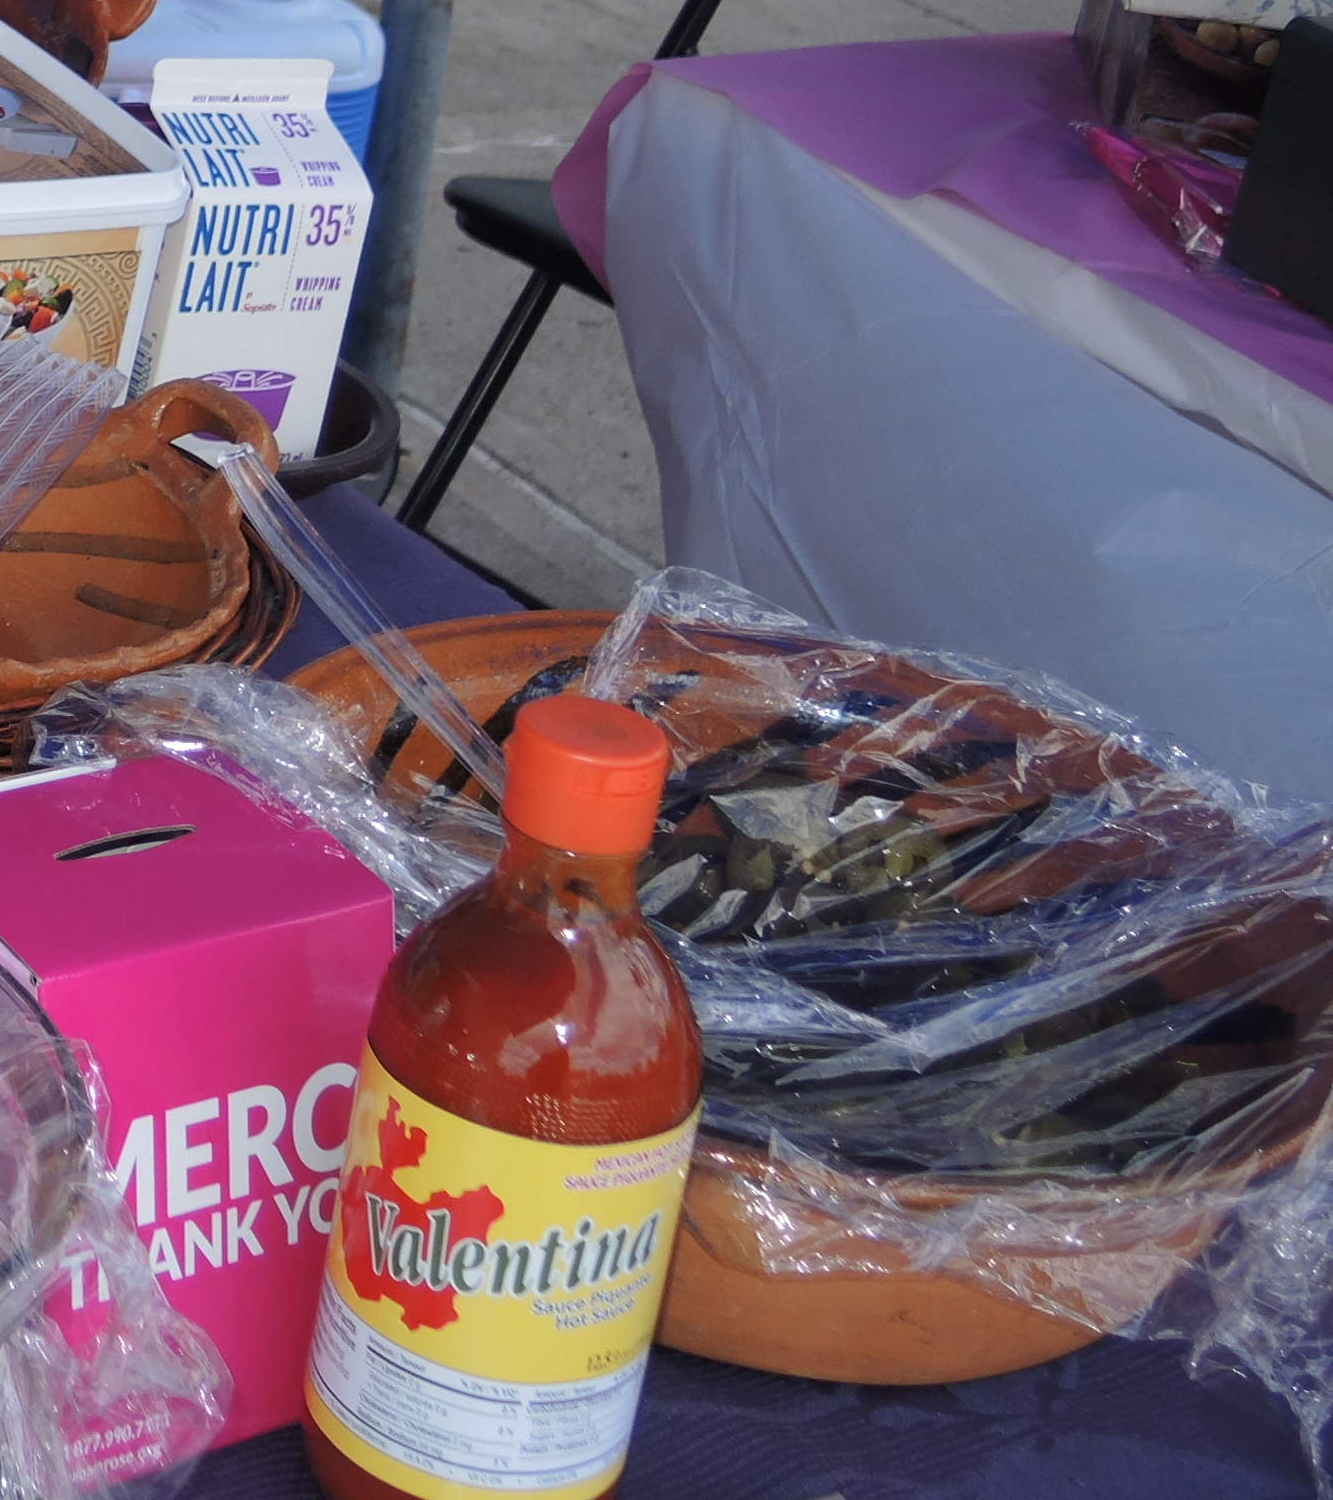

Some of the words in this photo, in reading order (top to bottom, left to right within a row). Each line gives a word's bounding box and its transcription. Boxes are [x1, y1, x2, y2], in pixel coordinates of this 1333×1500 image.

[161, 112, 261, 146] NUTRI
[182, 148, 251, 187] LAIT
[300, 161, 342, 172] WHIPPING
[307, 175, 335, 187] CREAM
[190, 203, 295, 257] NUTRI
[178, 261, 253, 314] LAIT
[295, 276, 343, 291] WHIPPING
[289, 296, 324, 312] CREAM
[563, 1174, 611, 1191] SAUCE
[365, 1190, 663, 1298] Valentina
[532, 1298, 586, 1316] Sauce
[590, 1272, 652, 1307] Piquante
[555, 1312, 587, 1330] Hot
[591, 1297, 635, 1324] Sauce
